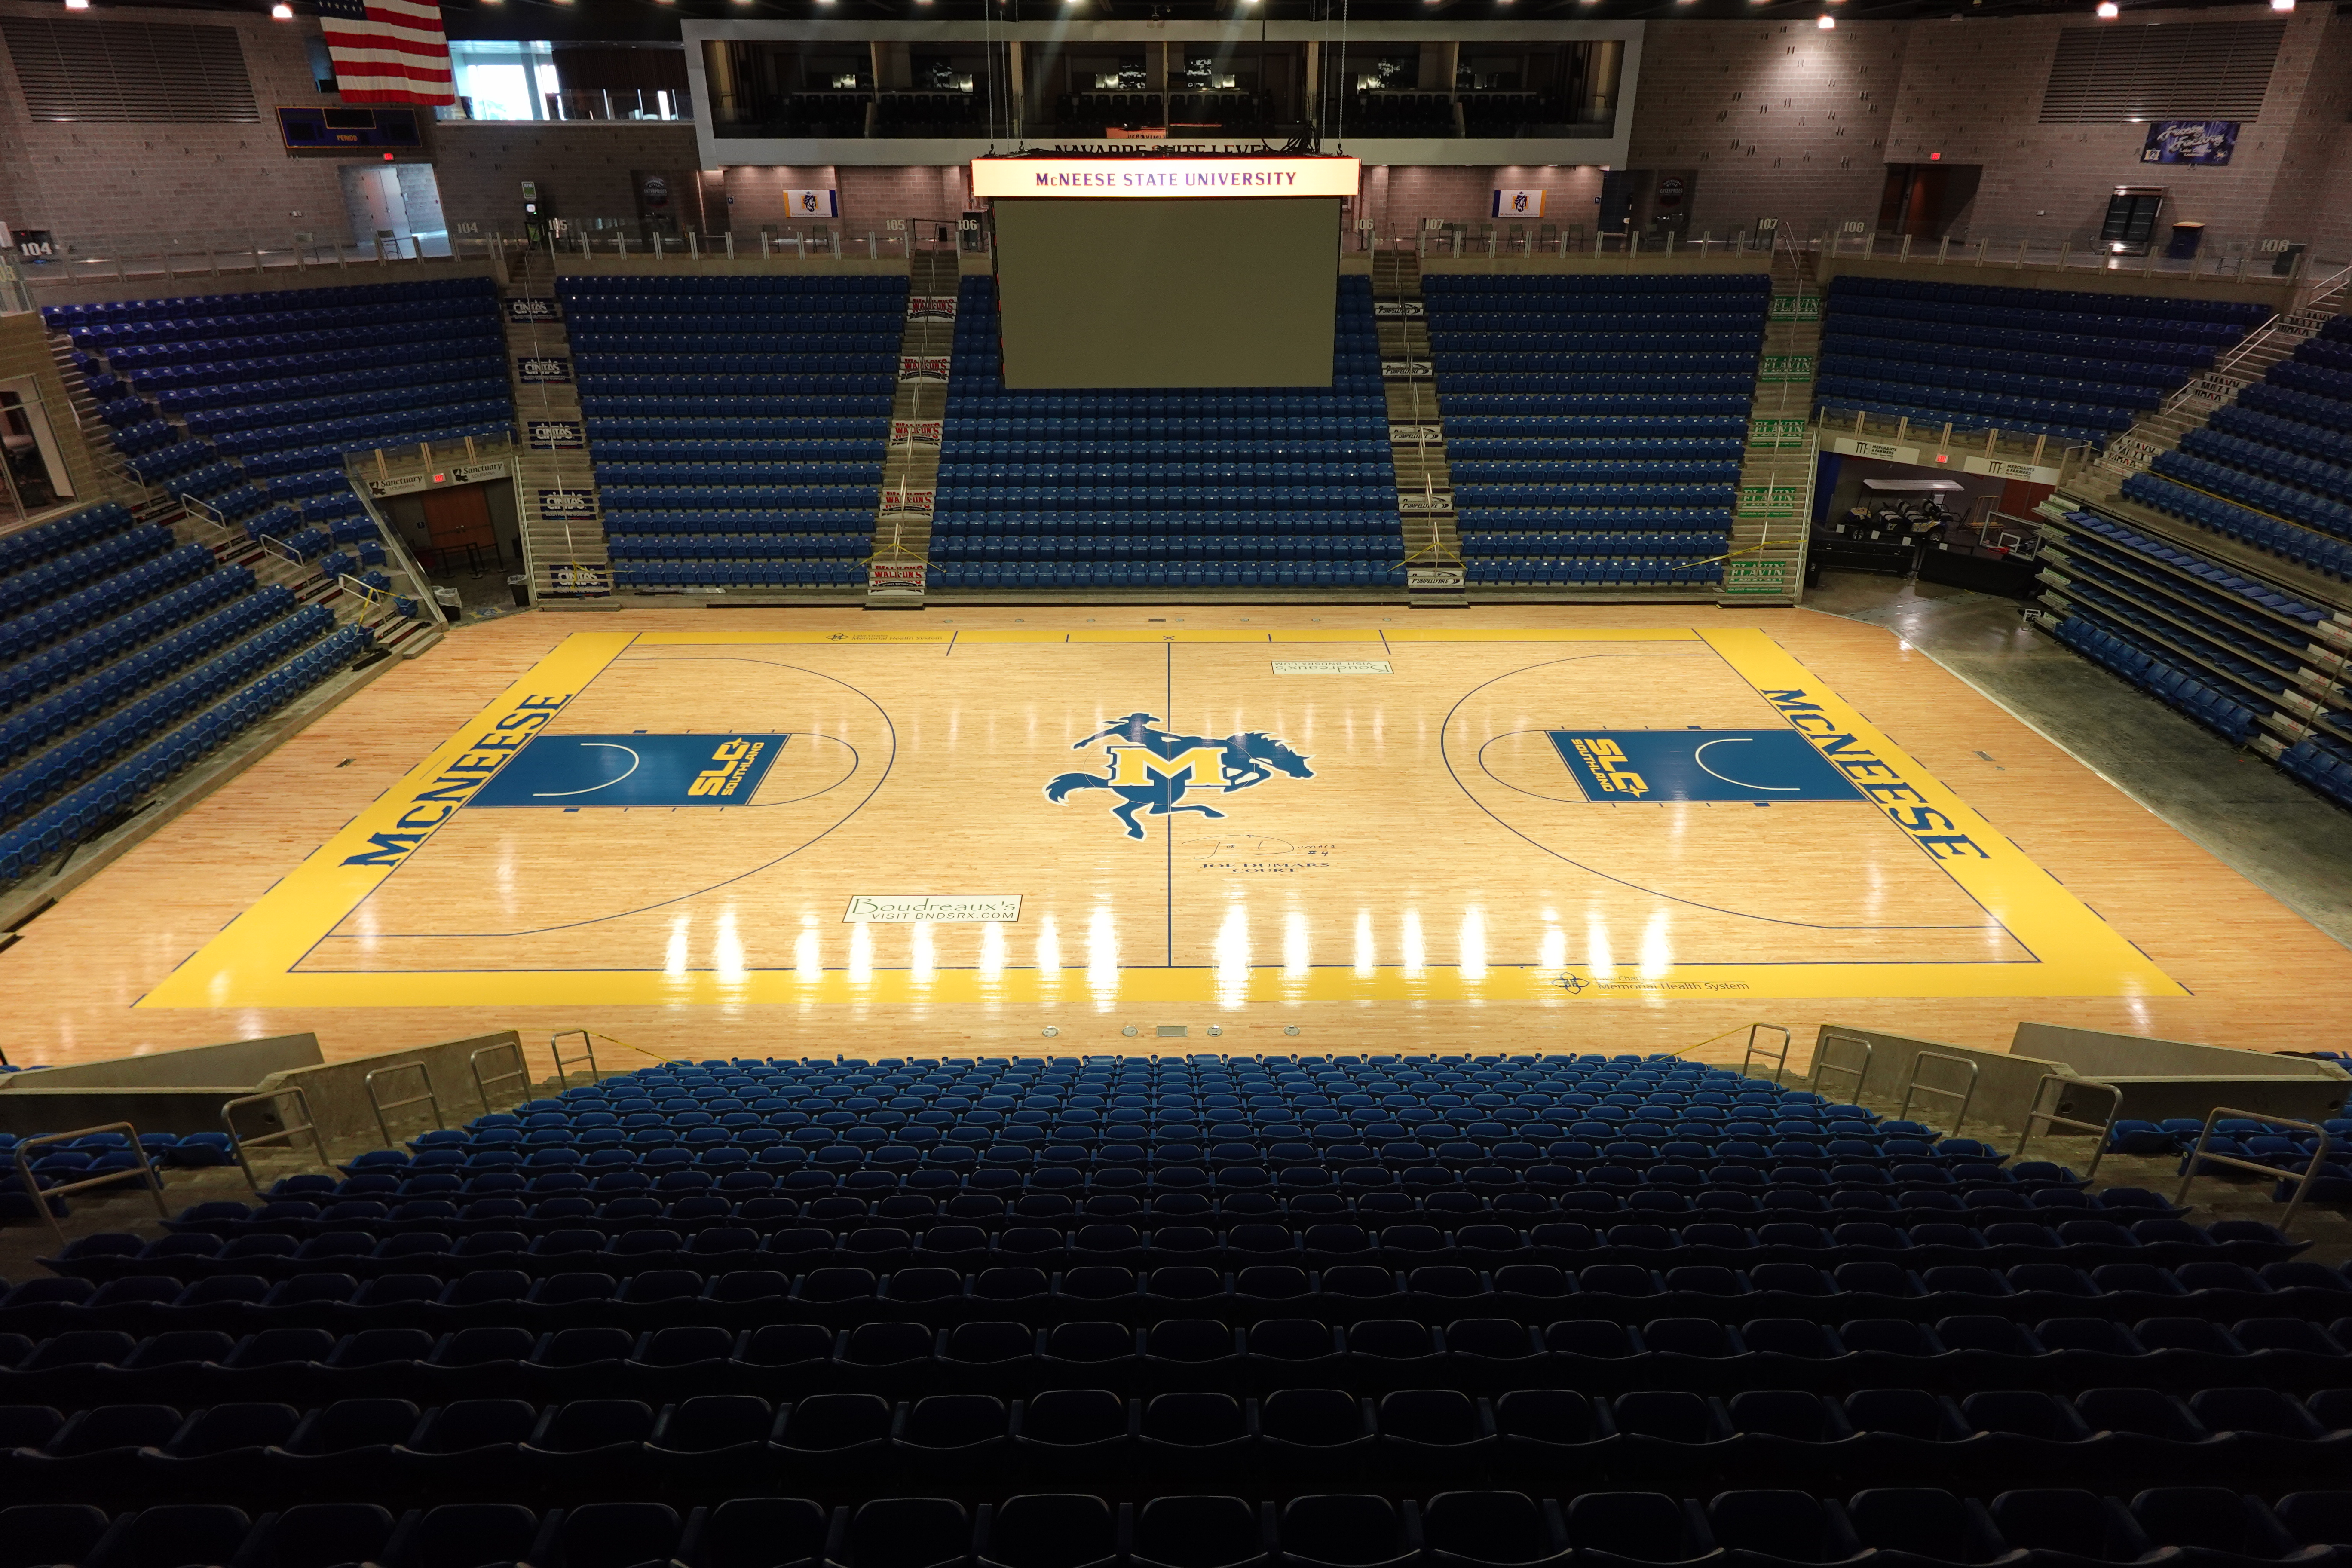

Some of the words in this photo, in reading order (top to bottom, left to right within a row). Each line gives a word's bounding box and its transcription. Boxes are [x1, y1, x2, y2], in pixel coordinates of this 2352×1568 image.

[1036, 173, 1116, 186] McNEESE
[1124, 173, 1177, 186] STATE
[1185, 172, 1296, 186] UNIVERSITY
[458, 222, 478, 233] 104
[548, 220, 568, 230] 105
[886, 220, 905, 230] 105
[958, 219, 977, 230] 106
[1354, 219, 1374, 230] 106
[1426, 219, 1445, 230] 107
[1759, 218, 1778, 230] 107
[1844, 221, 1865, 233] 108
[21, 242, 53, 256] 104
[2261, 239, 2290, 253] 108
[513, 299, 548, 314] CINTAS
[1773, 298, 1820, 312] FLAVIN
[525, 358, 560, 375] CINTAS
[1764, 358, 1813, 372] FLAVIN
[536, 423, 573, 440] CINTAS
[1753, 422, 1804, 436] FLAVIN
[463, 462, 502, 475] Sanctuary
[381, 475, 423, 487] Sanctuary
[389, 482, 416, 491] LOUISIANA
[546, 491, 585, 510] CINTAS
[886, 492, 932, 509] WAK-ON'S
[1742, 490, 1795, 506] FLAVIN
[558, 566, 598, 586] CINTAS
[1730, 564, 1785, 581] FLAVIN
[1276, 665, 1390, 673] Boudreaux's
[688, 737, 751, 796] SLC
[721, 742, 765, 796] SOUTHLAND
[1108, 747, 1231, 787] M
[1571, 739, 1615, 792] SOUTHLAND
[1584, 738, 1650, 798] SLC
[850, 898, 1016, 914] Boudreaux's
[1706, 982, 1750, 992] System
